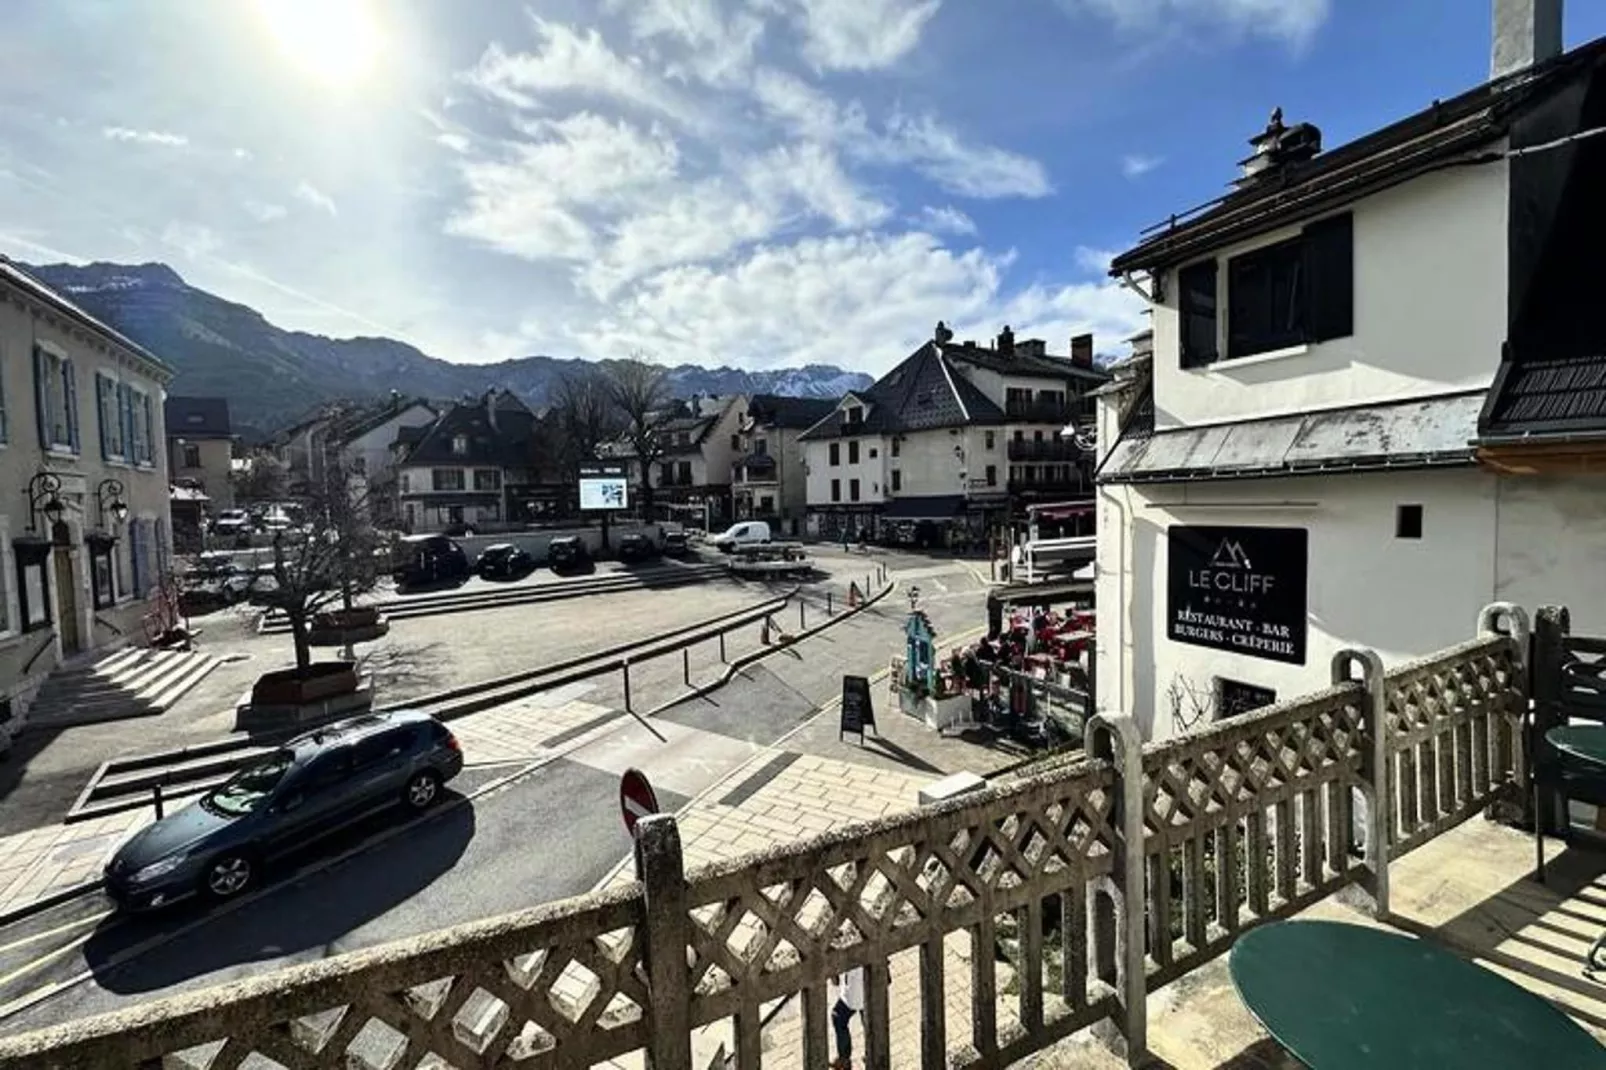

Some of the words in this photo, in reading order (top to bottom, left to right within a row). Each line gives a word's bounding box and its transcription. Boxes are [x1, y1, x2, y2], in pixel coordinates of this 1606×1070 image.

[1189, 570, 1211, 588] LE
[1214, 571, 1275, 594] CLIFF
[1174, 623, 1224, 643] BURGERS
[1262, 623, 1290, 638] BAR
